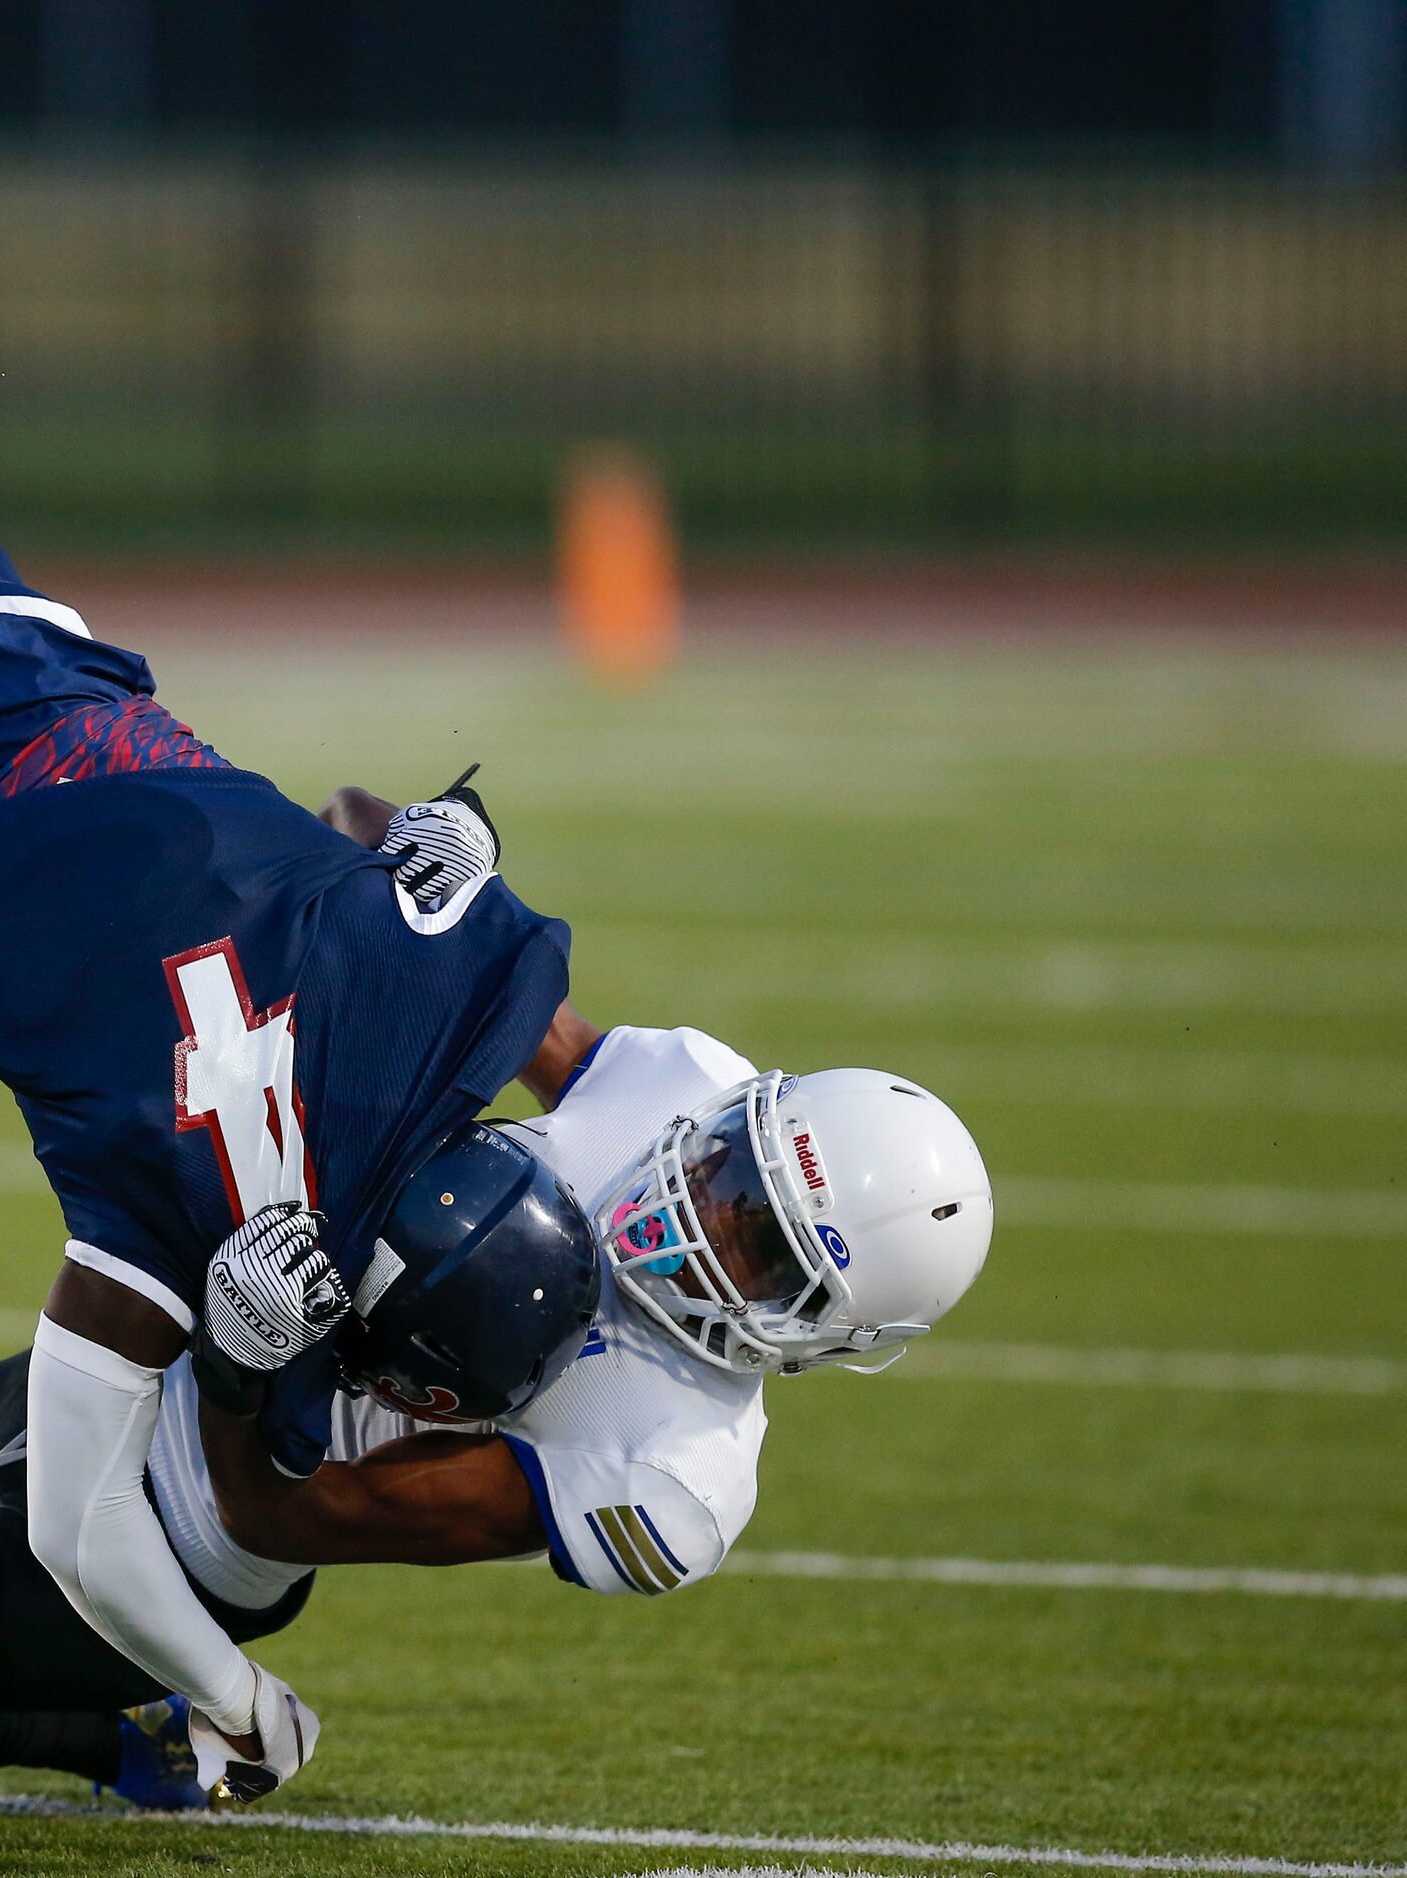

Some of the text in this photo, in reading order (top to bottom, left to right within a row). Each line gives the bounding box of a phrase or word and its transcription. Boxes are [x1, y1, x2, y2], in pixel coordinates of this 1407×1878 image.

[162, 935, 319, 1227] 4
[793, 1134, 826, 1190] Riddell
[215, 1269, 282, 1344] BATTLE
